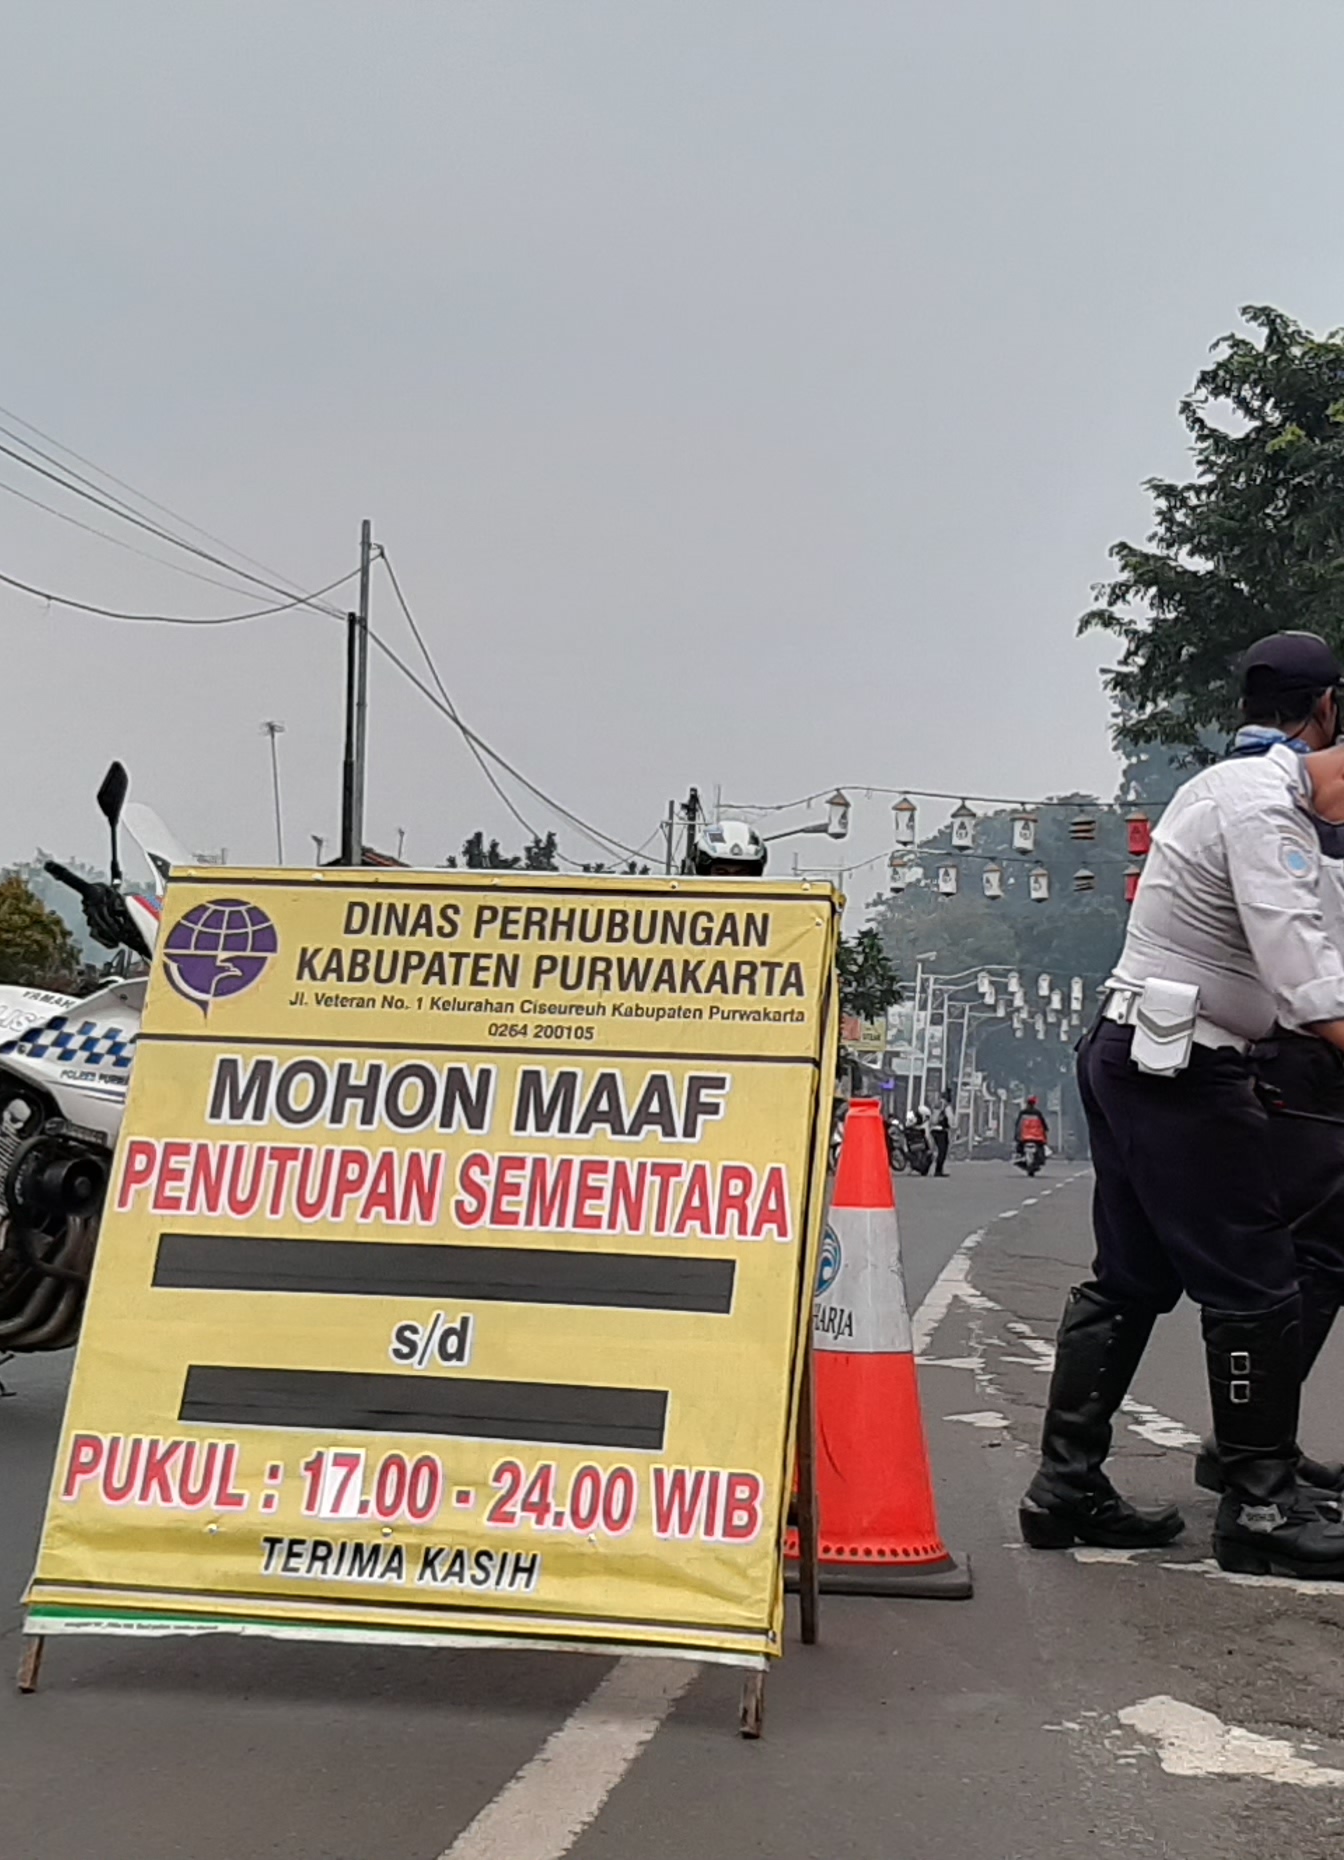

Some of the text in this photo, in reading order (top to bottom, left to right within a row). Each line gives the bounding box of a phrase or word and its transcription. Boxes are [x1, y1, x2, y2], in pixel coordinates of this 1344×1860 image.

[343, 901, 769, 947] DINAS PERHUBUNGAN
[296, 947, 805, 997] KABUPATEN PURWAKARTA
[22, 990, 77, 1009] YAMAH
[288, 991, 805, 1022] Jl. Veteran No. 1 Kelurahan Ciseureuh Kabupaten Purwakarta
[487, 1022, 595, 1040] 0264 200105
[208, 1057, 727, 1138] MOHON MAAF
[117, 1139, 790, 1238] PENUTUPAN SEMENTARA
[392, 1312, 471, 1366] s/d
[63, 1434, 247, 1509] PUKUL
[303, 1448, 440, 1520] 17.00
[486, 1460, 634, 1533] 24.00
[653, 1466, 762, 1540] WIB
[262, 1535, 539, 1590] TERIMA KASIH
